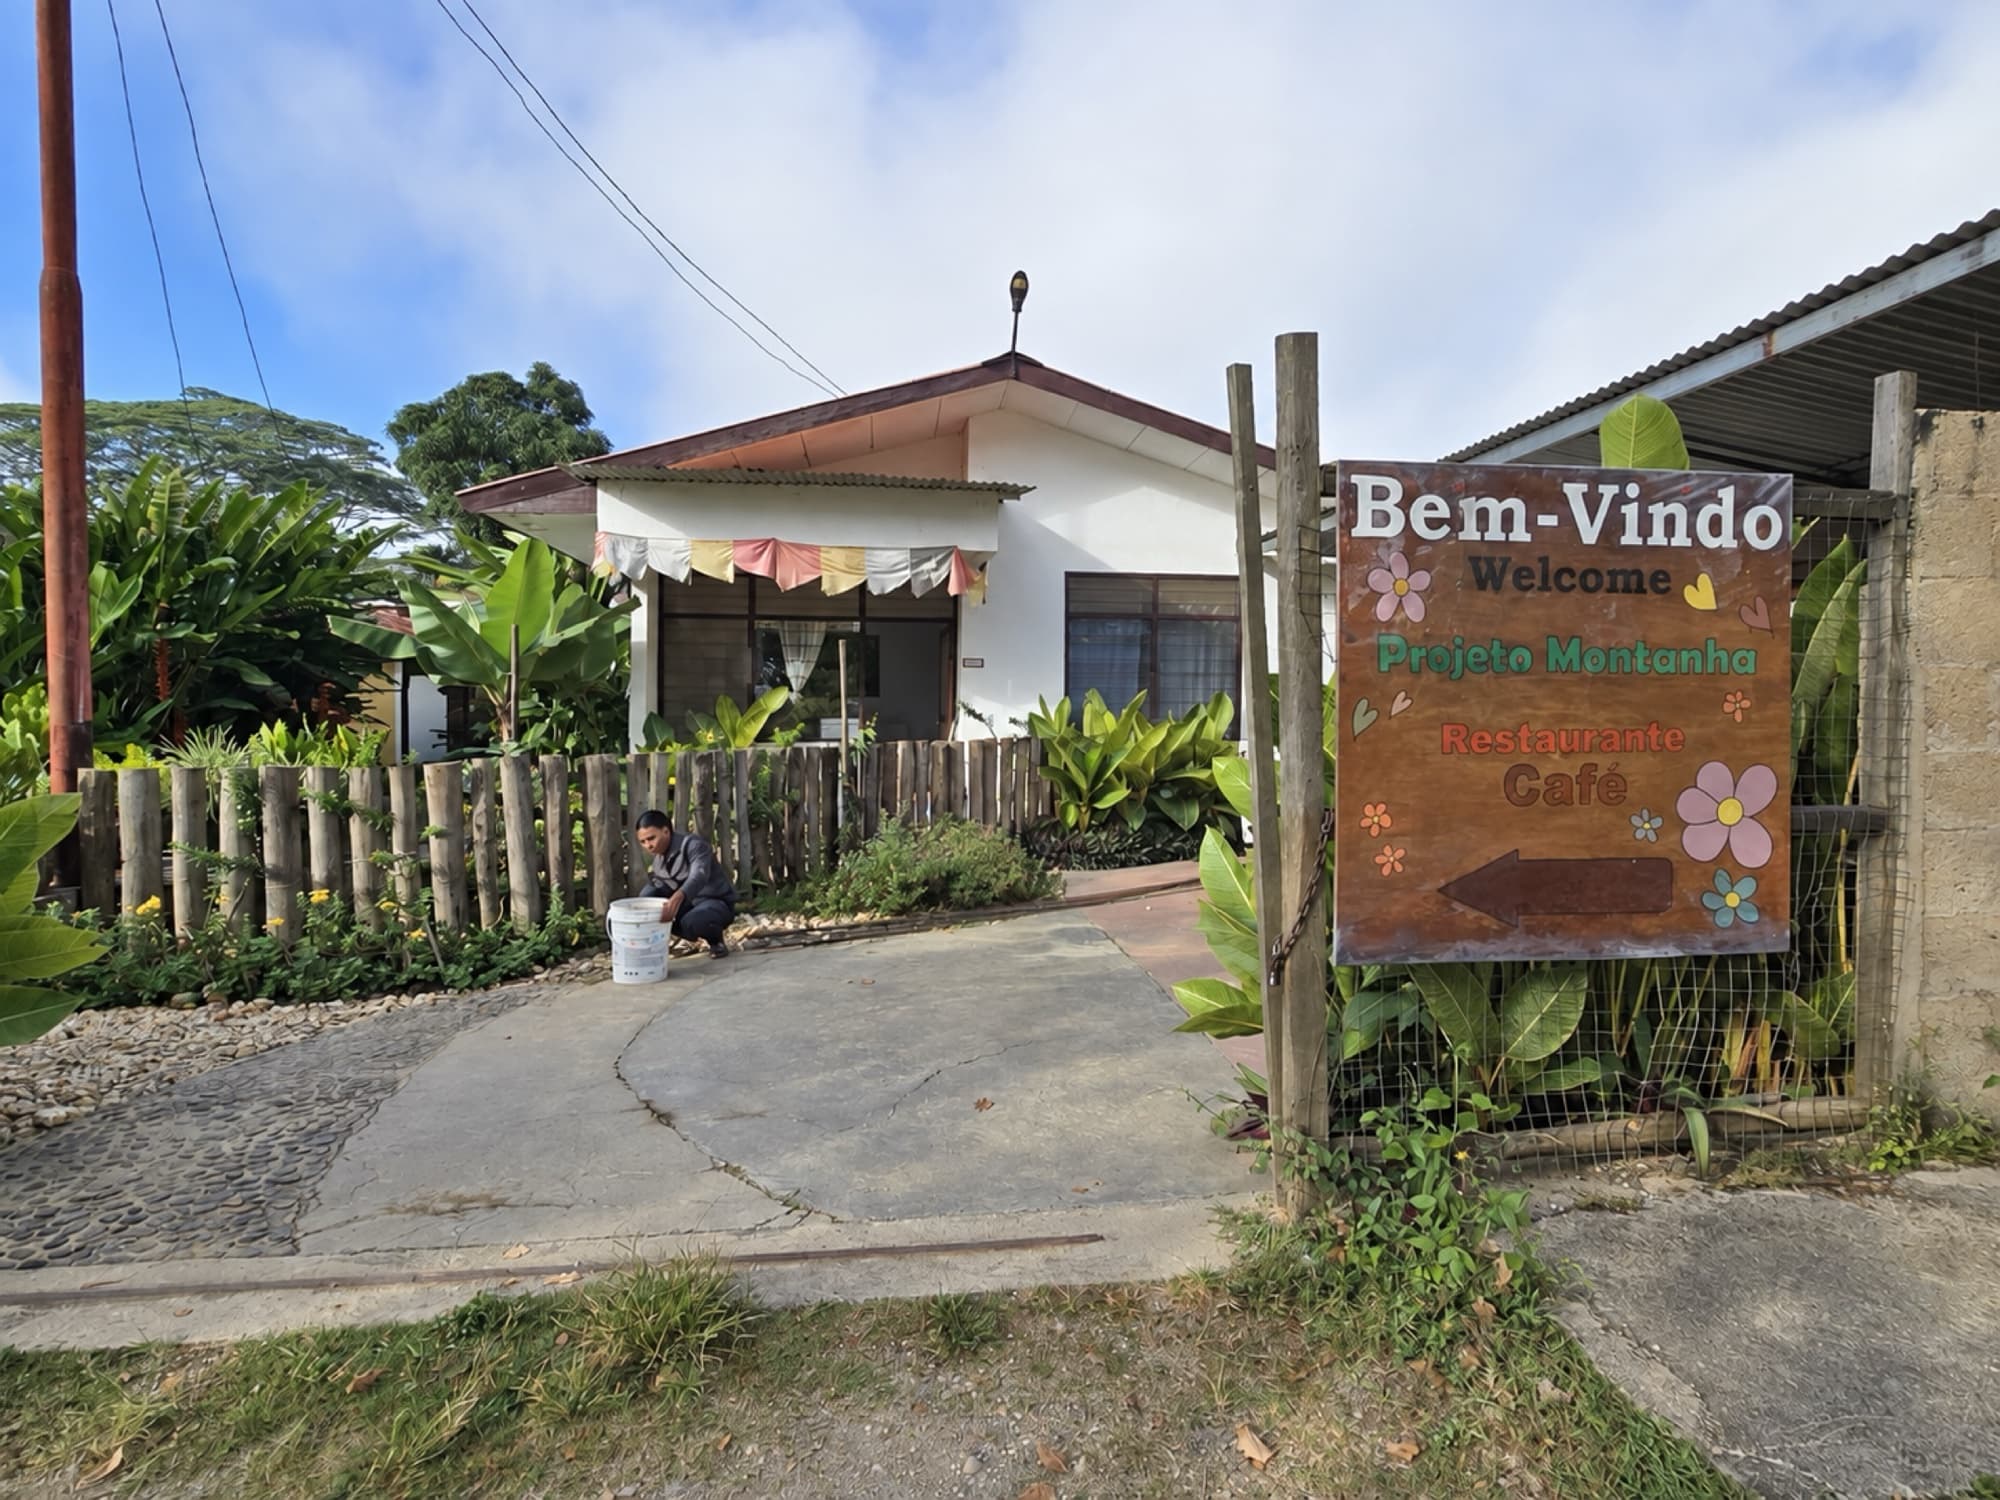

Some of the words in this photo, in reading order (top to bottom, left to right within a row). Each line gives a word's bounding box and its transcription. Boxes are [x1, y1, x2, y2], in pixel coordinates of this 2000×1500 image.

[1350, 475, 1782, 549] Bem-Vindo
[1470, 556, 1671, 594] Welcome
[1378, 635, 1533, 679] Projeto
[1547, 637, 1757, 674] Montanha
[1442, 722, 1684, 754] Restaurante
[1503, 762, 1628, 807] Café
